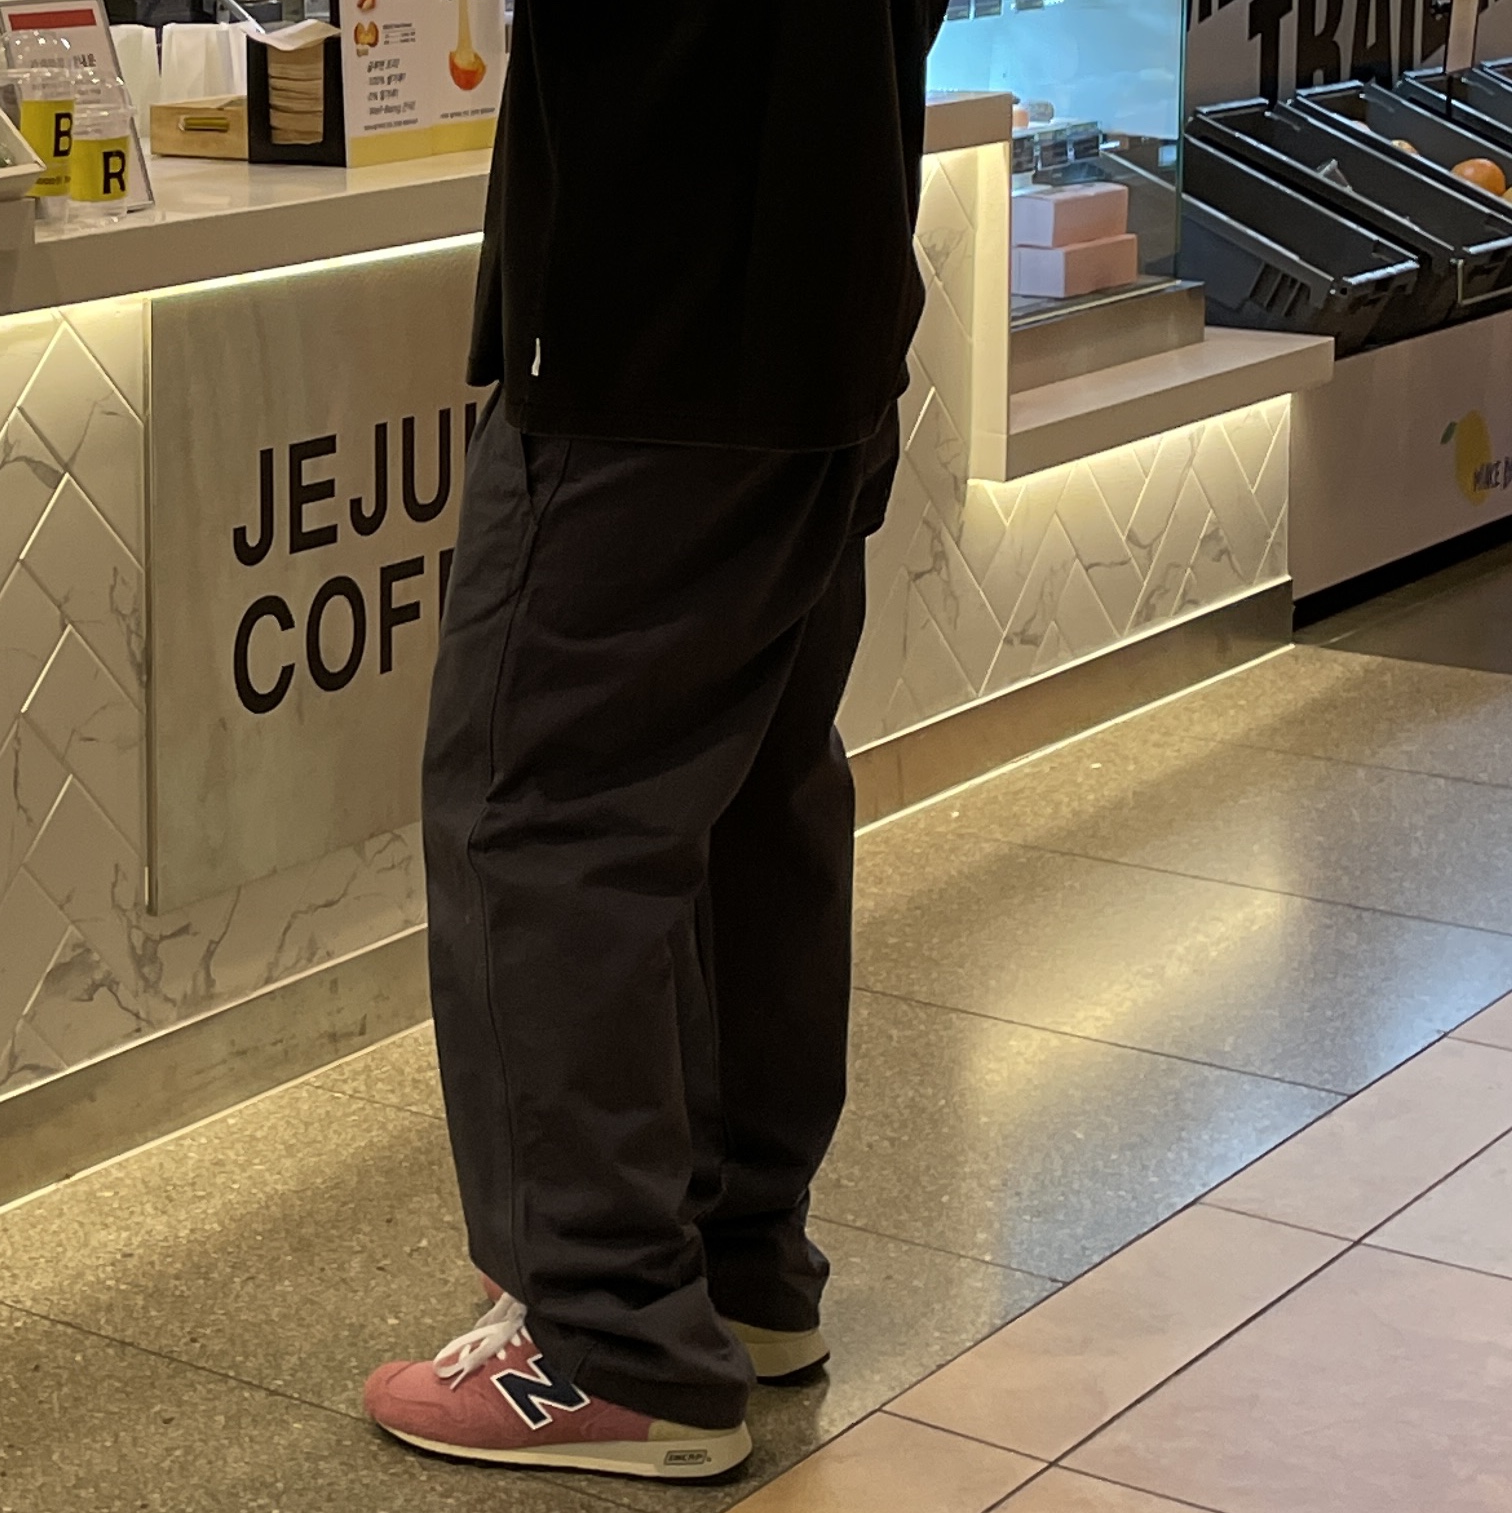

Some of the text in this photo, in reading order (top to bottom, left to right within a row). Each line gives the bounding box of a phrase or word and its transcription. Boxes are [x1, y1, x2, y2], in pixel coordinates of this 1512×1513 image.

[53, 112, 73, 158] B
[102, 150, 126, 194] R
[490, 1354, 591, 1431] N
